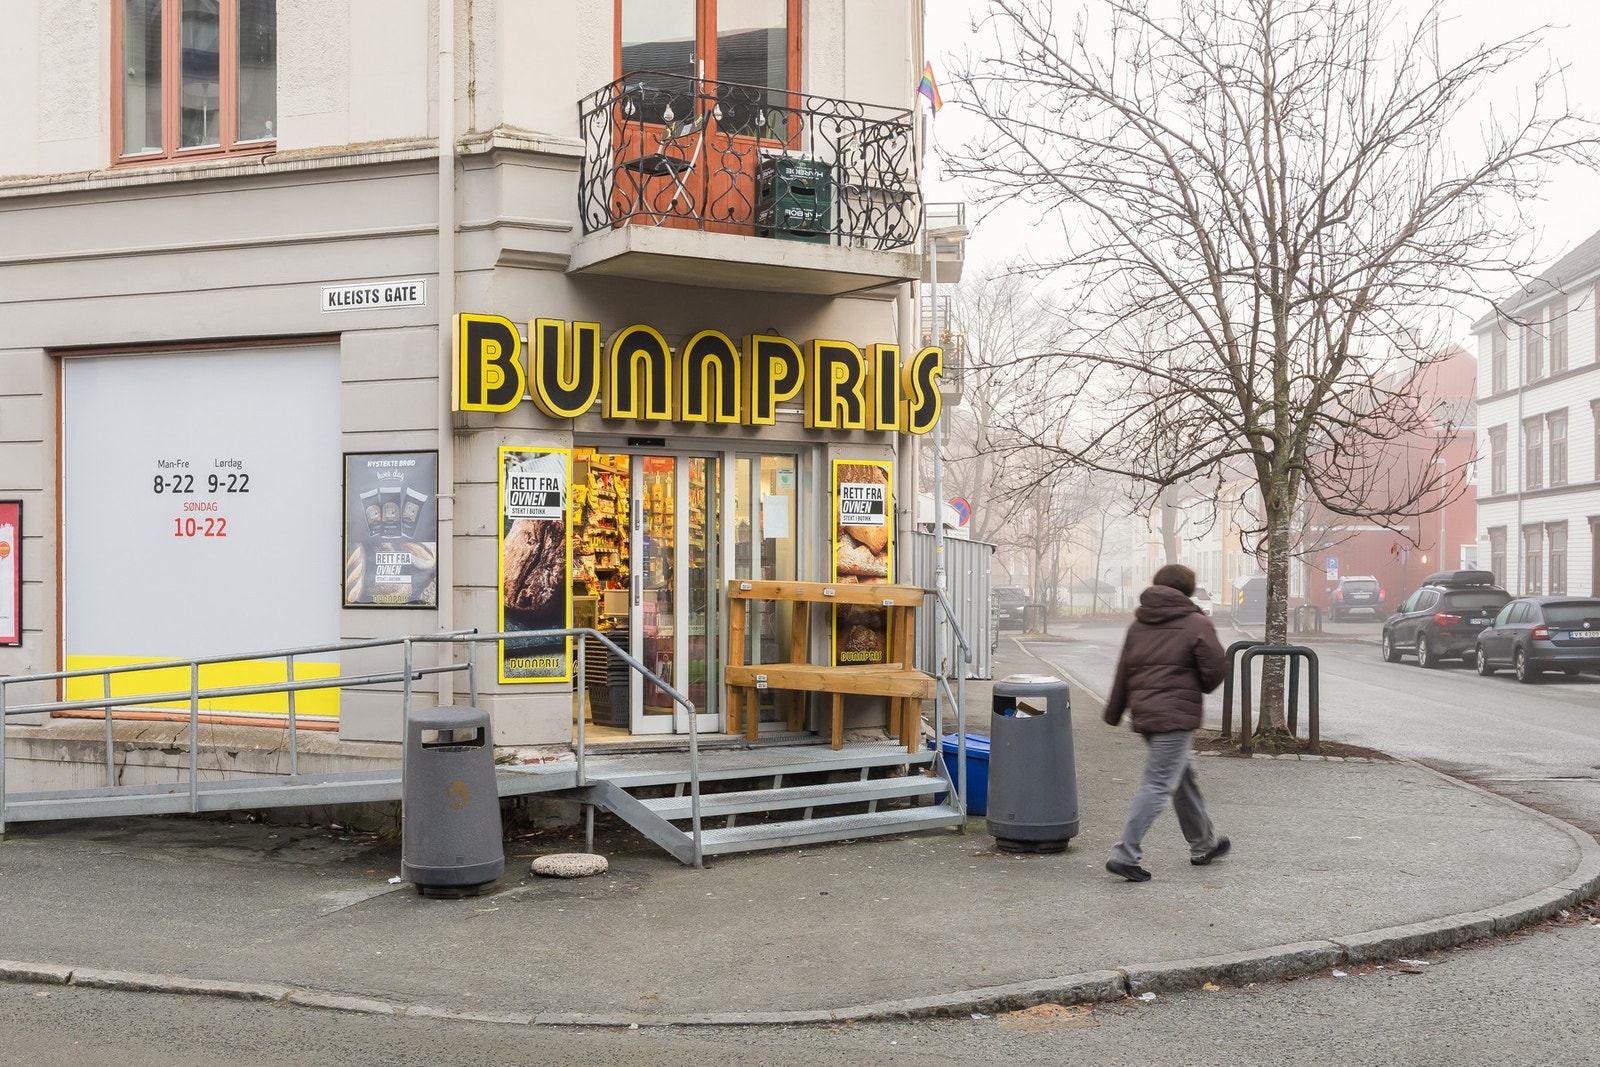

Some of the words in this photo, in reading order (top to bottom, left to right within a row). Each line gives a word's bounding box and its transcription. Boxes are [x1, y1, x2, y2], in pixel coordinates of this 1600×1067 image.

[328, 289, 380, 306] KLEISTS
[384, 286, 417, 302] GATE
[452, 312, 944, 435] BUNNPRIS
[157, 459, 190, 468] Man-Fre
[214, 458, 243, 470] Lørdag
[153, 475, 194, 494] 8-22
[207, 474, 249, 493] 9-22
[512, 476, 537, 490] RETT
[540, 477, 559, 491] FRA
[511, 491, 547, 506] OVNEN
[843, 487, 864, 499] RETT
[865, 487, 882, 500] FRA
[183, 502, 218, 512] SØNDAG
[843, 500, 872, 514] OVNEN
[174, 518, 227, 537] 10-22
[376, 554, 395, 564] RETT
[396, 554, 410, 564] FRA
[376, 564, 402, 575] OVNEN
[509, 656, 561, 670] BUNNPRIS
